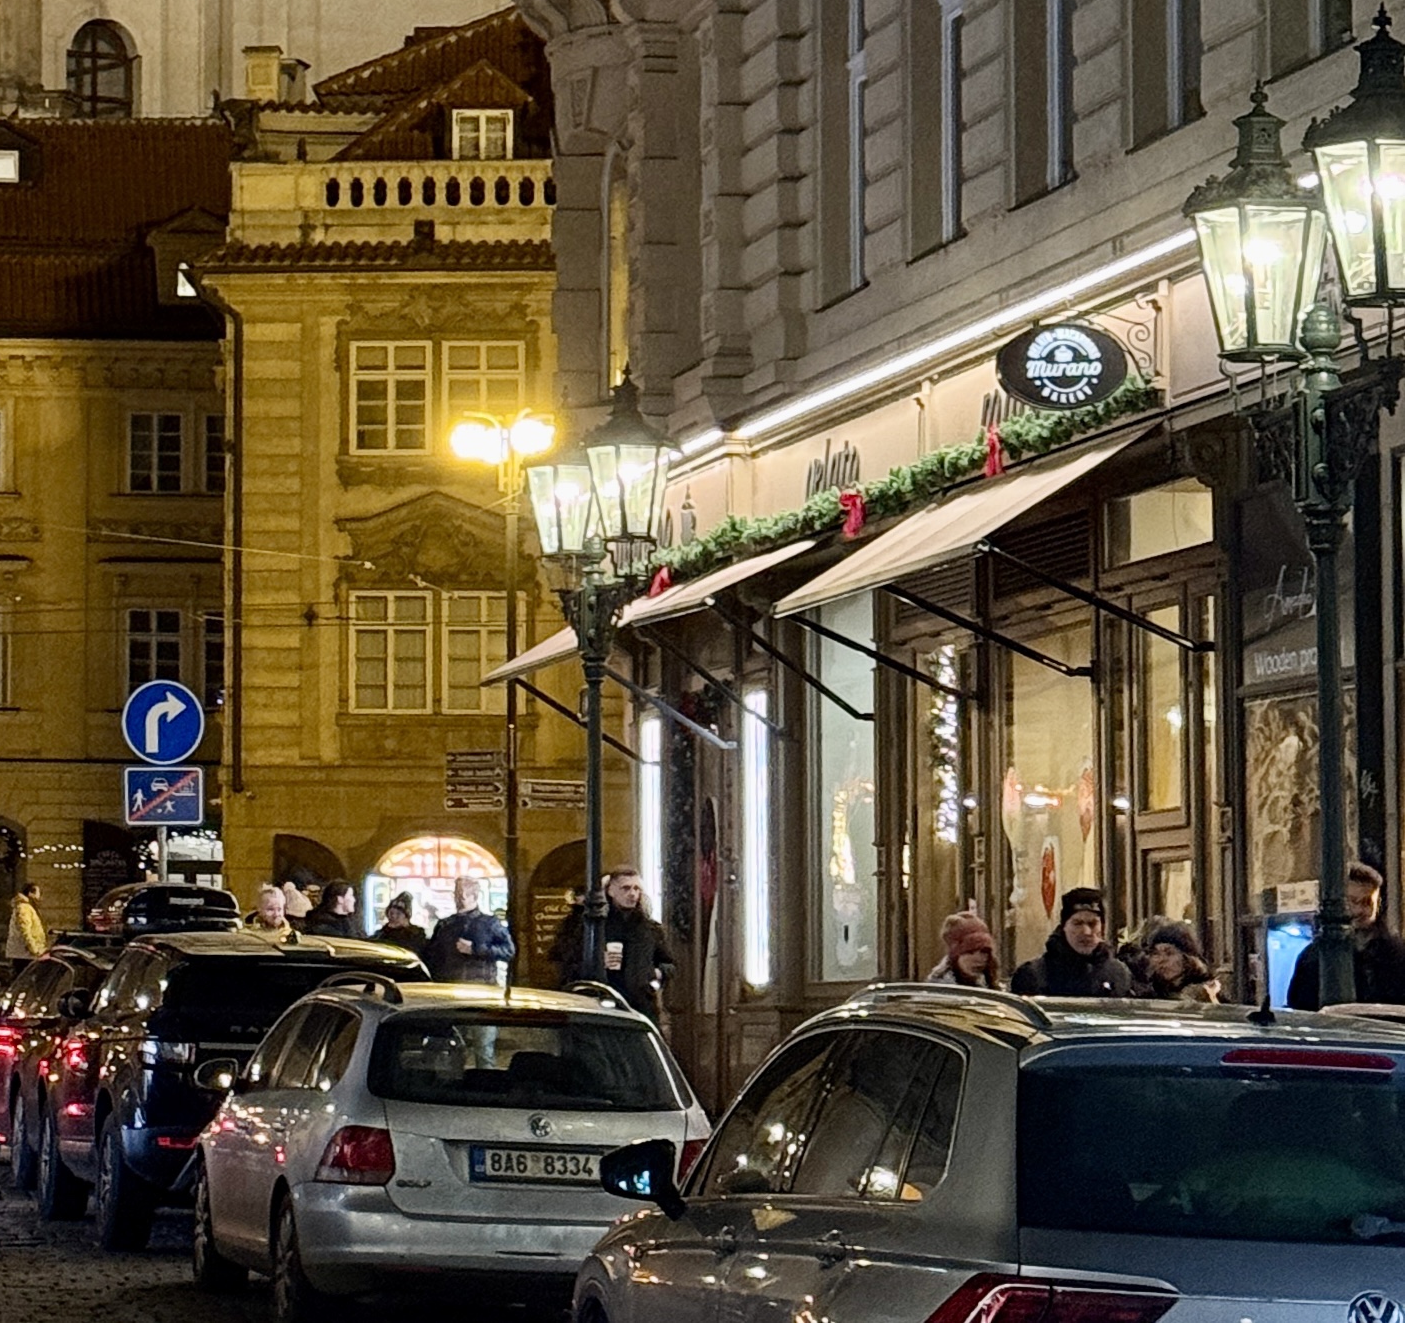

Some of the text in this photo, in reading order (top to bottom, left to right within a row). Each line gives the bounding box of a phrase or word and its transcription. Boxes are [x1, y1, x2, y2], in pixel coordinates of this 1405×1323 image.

[1026, 360, 1102, 378] Murano
[1255, 646, 1297, 675] Wooden
[491, 1153, 593, 1177] 8A6 8334
